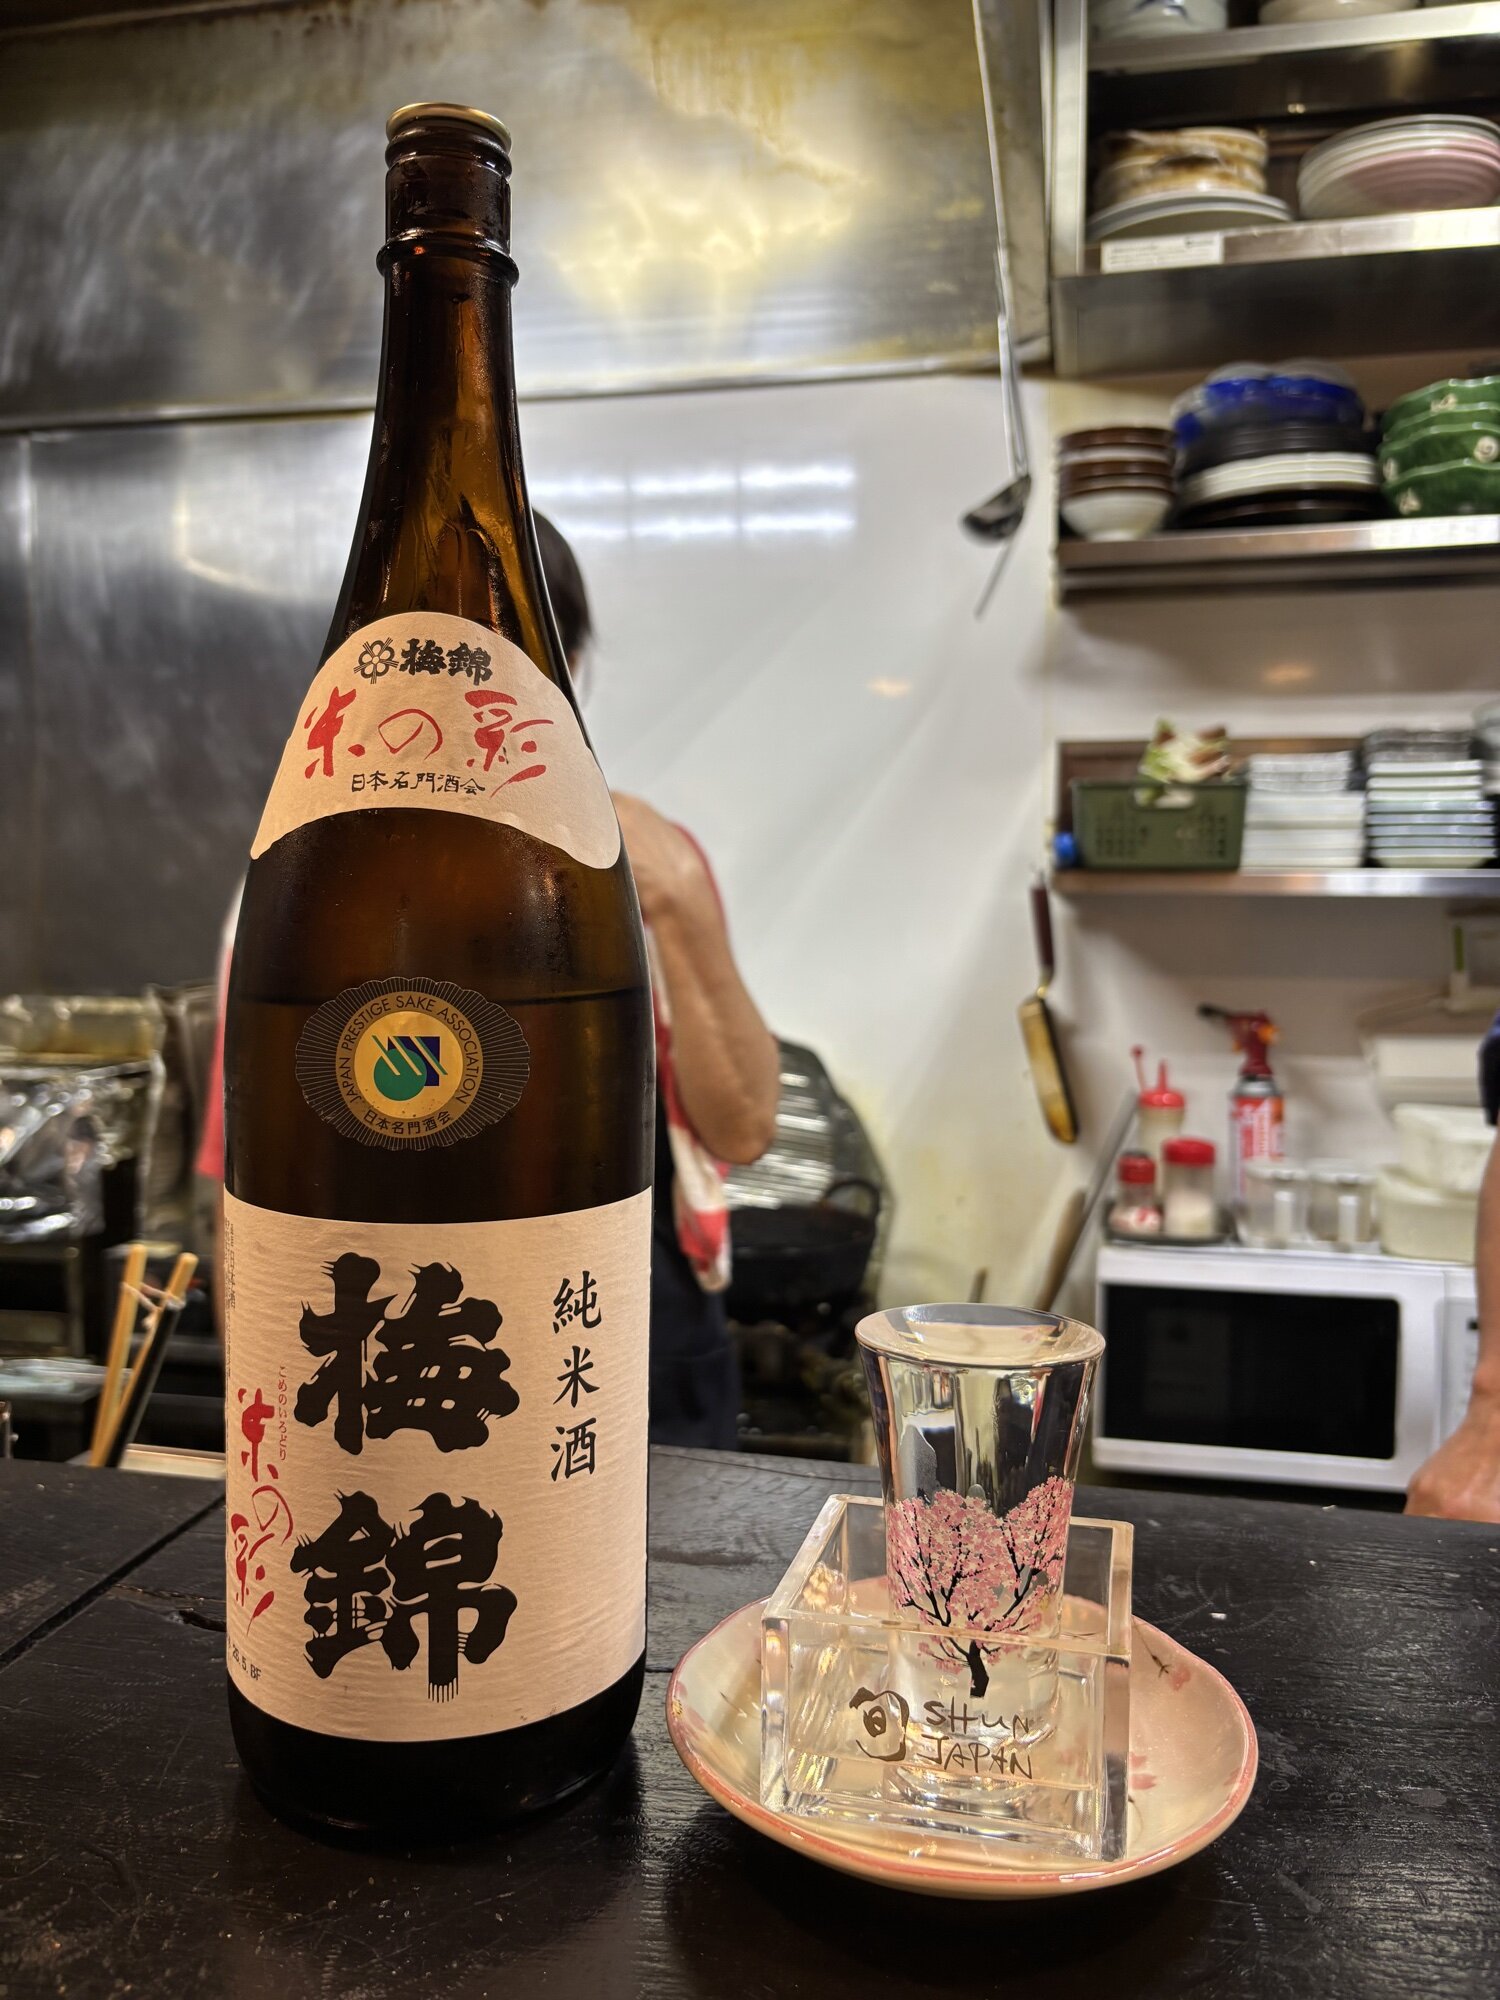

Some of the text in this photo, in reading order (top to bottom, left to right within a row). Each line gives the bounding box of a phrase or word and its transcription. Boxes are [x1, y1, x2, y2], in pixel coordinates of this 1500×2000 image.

[398, 637, 493, 686] 梅錦
[350, 770, 486, 796] 日本名門酒会
[339, 995, 480, 1105] JAPAN PRESTIGE SAKE ASSOCIATION
[363, 1108, 451, 1135] 日本名門酒会
[549, 1269, 602, 1482] 純米酒
[277, 1365, 288, 1461] こめのいろどり
[289, 1251, 521, 1703] 梅錦
[923, 1696, 1030, 1739] SHUN
[917, 1733, 1033, 1780] JAPAN
